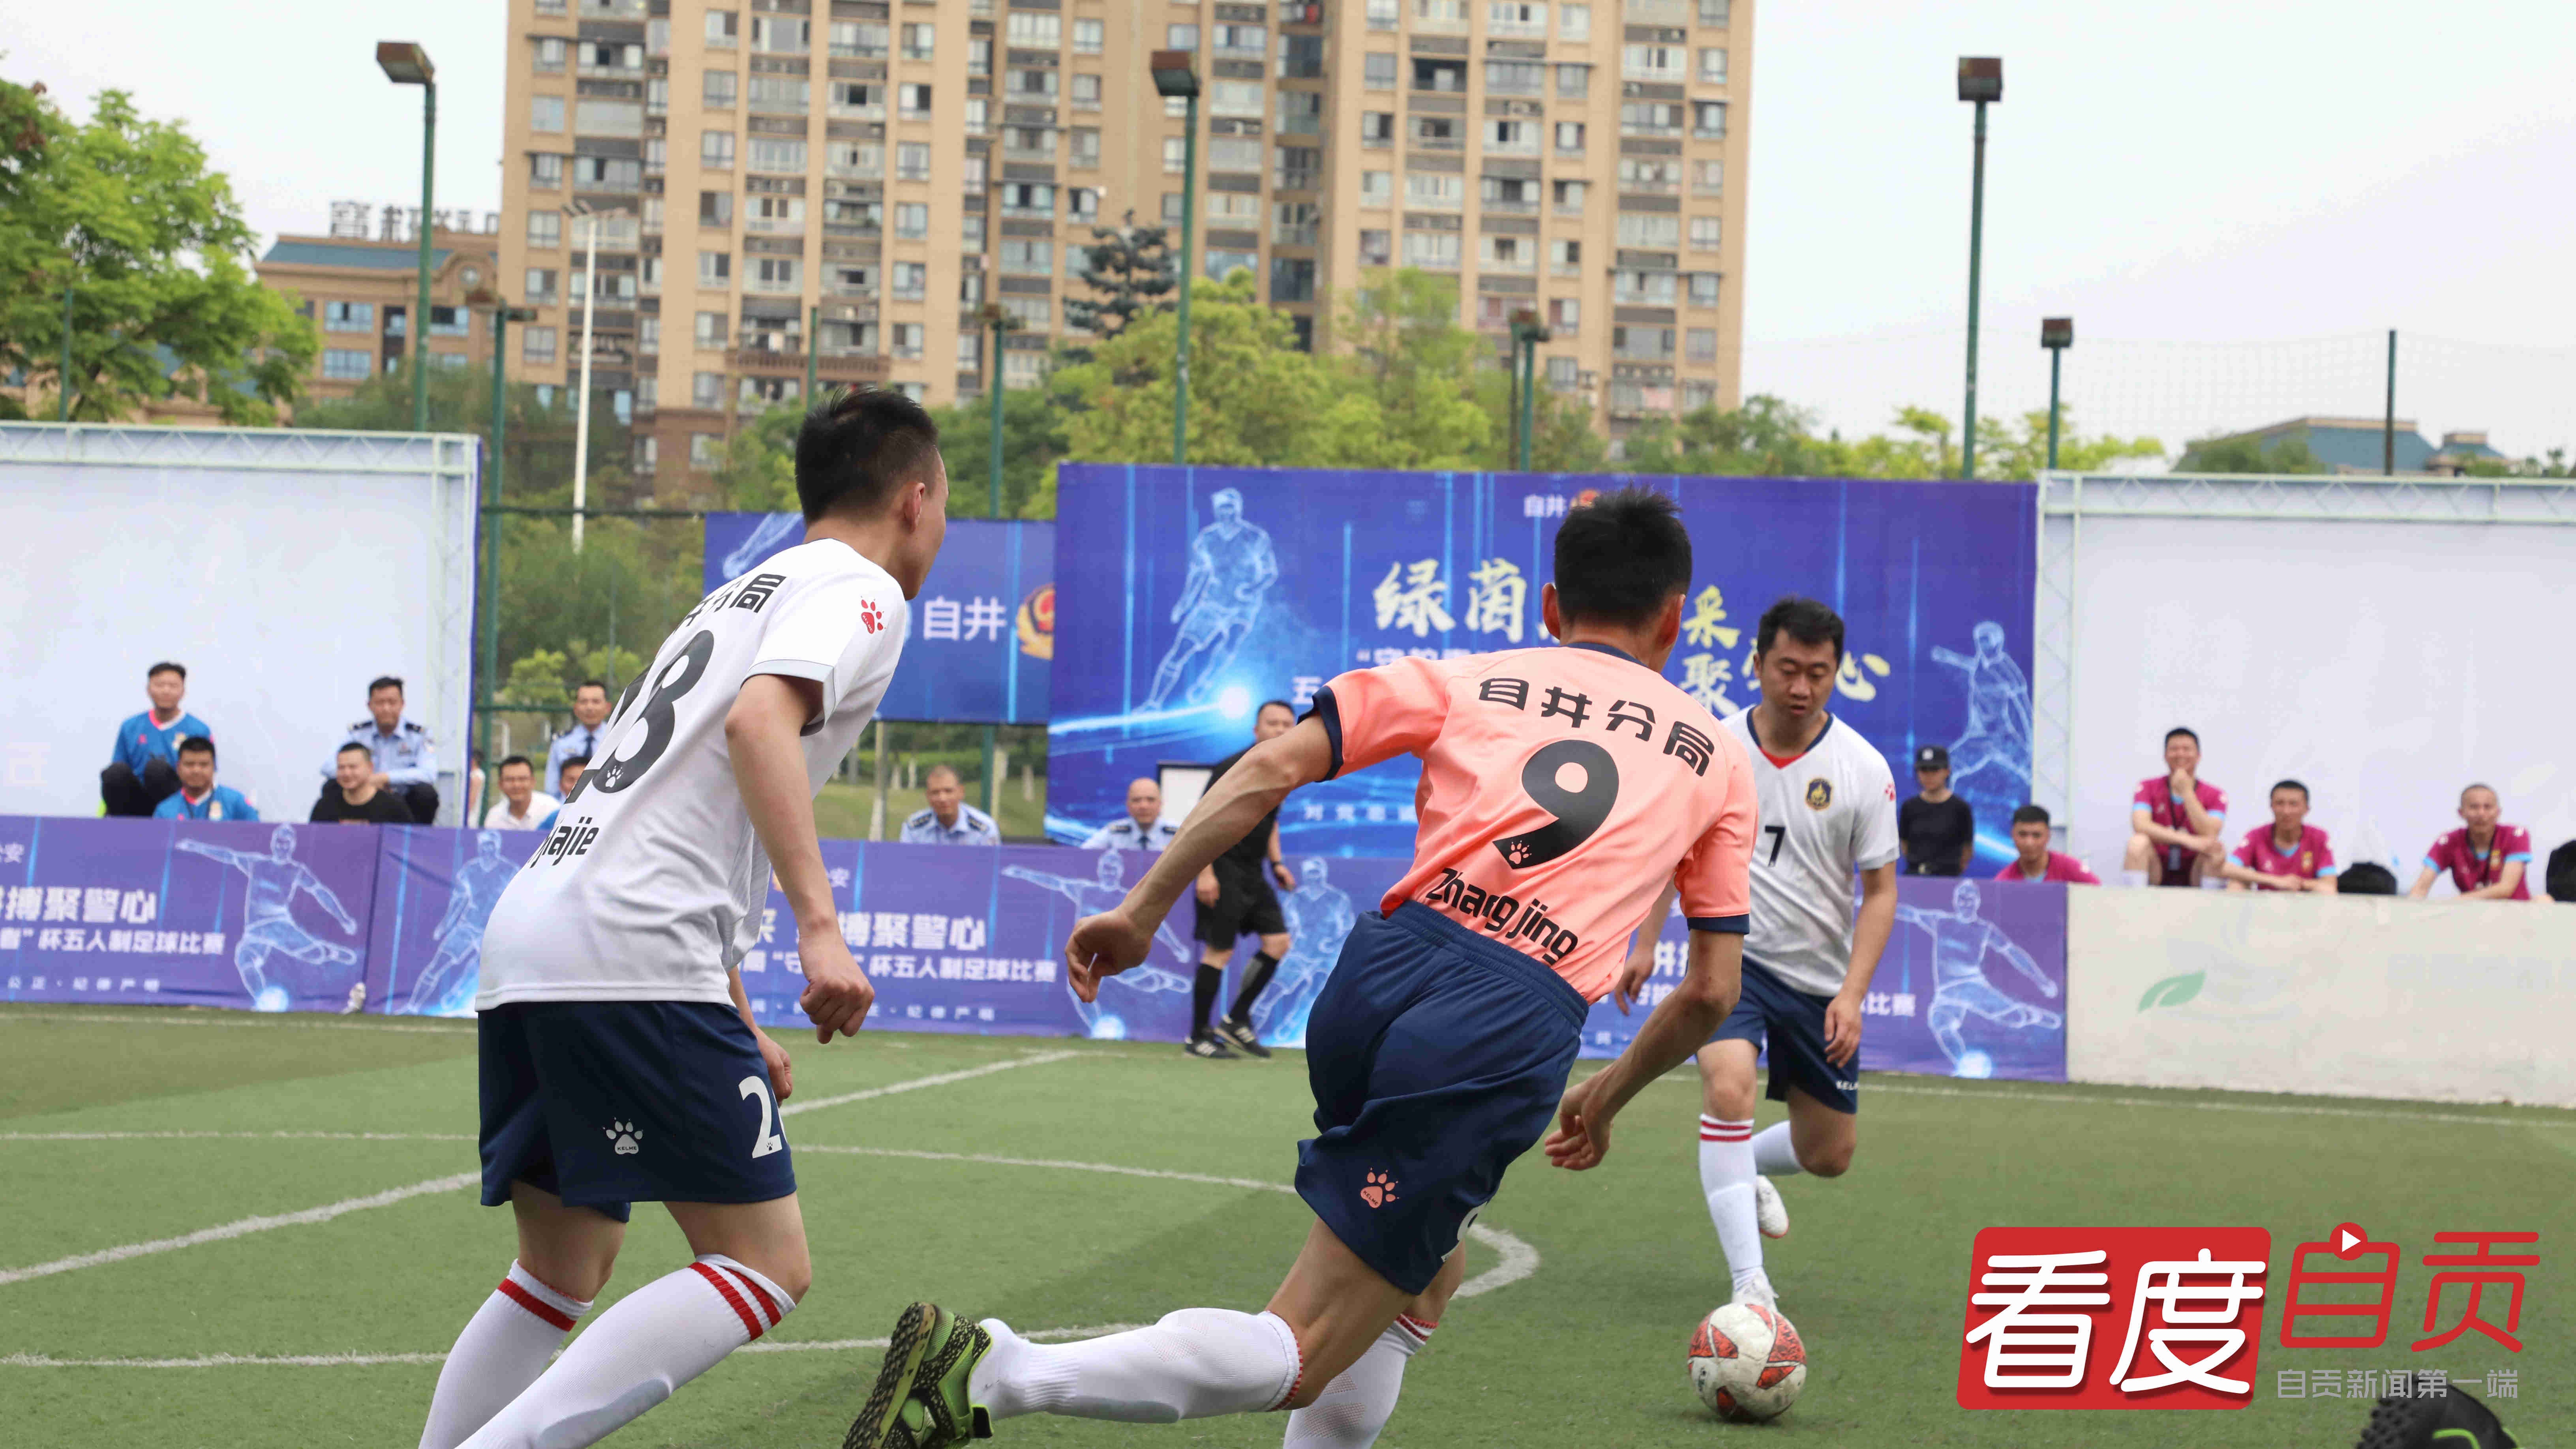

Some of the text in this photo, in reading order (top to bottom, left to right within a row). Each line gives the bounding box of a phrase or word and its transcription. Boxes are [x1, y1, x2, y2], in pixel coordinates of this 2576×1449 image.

[1524, 494, 1567, 518] 自井
[923, 595, 1008, 642] 自井
[1478, 677, 1715, 777] 自井分局
[1492, 739, 1620, 870] 9
[1764, 825, 1786, 867] 7
